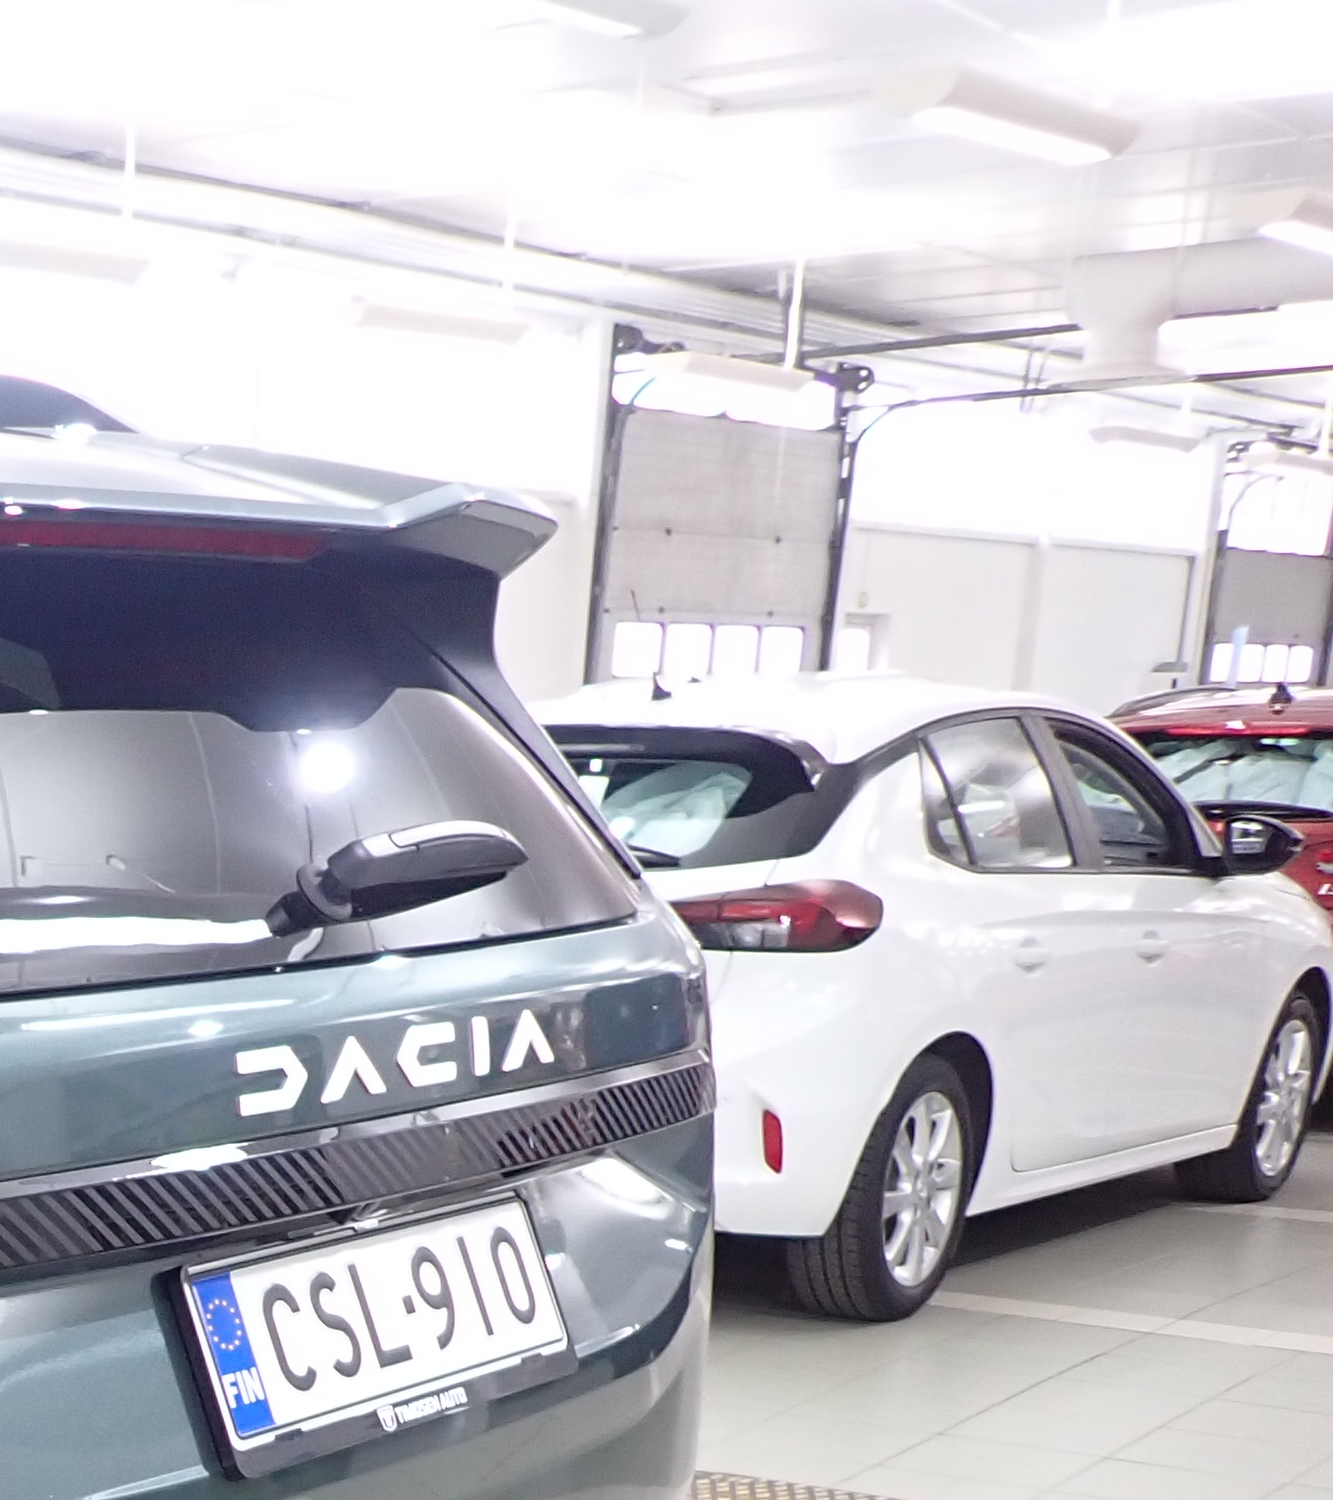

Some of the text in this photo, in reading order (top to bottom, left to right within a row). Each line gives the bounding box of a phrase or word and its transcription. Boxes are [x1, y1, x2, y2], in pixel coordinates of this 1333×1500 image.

[235, 1009, 555, 1117] DACIA
[261, 1225, 536, 1393] CSL-910
[221, 1366, 265, 1409] FIN
